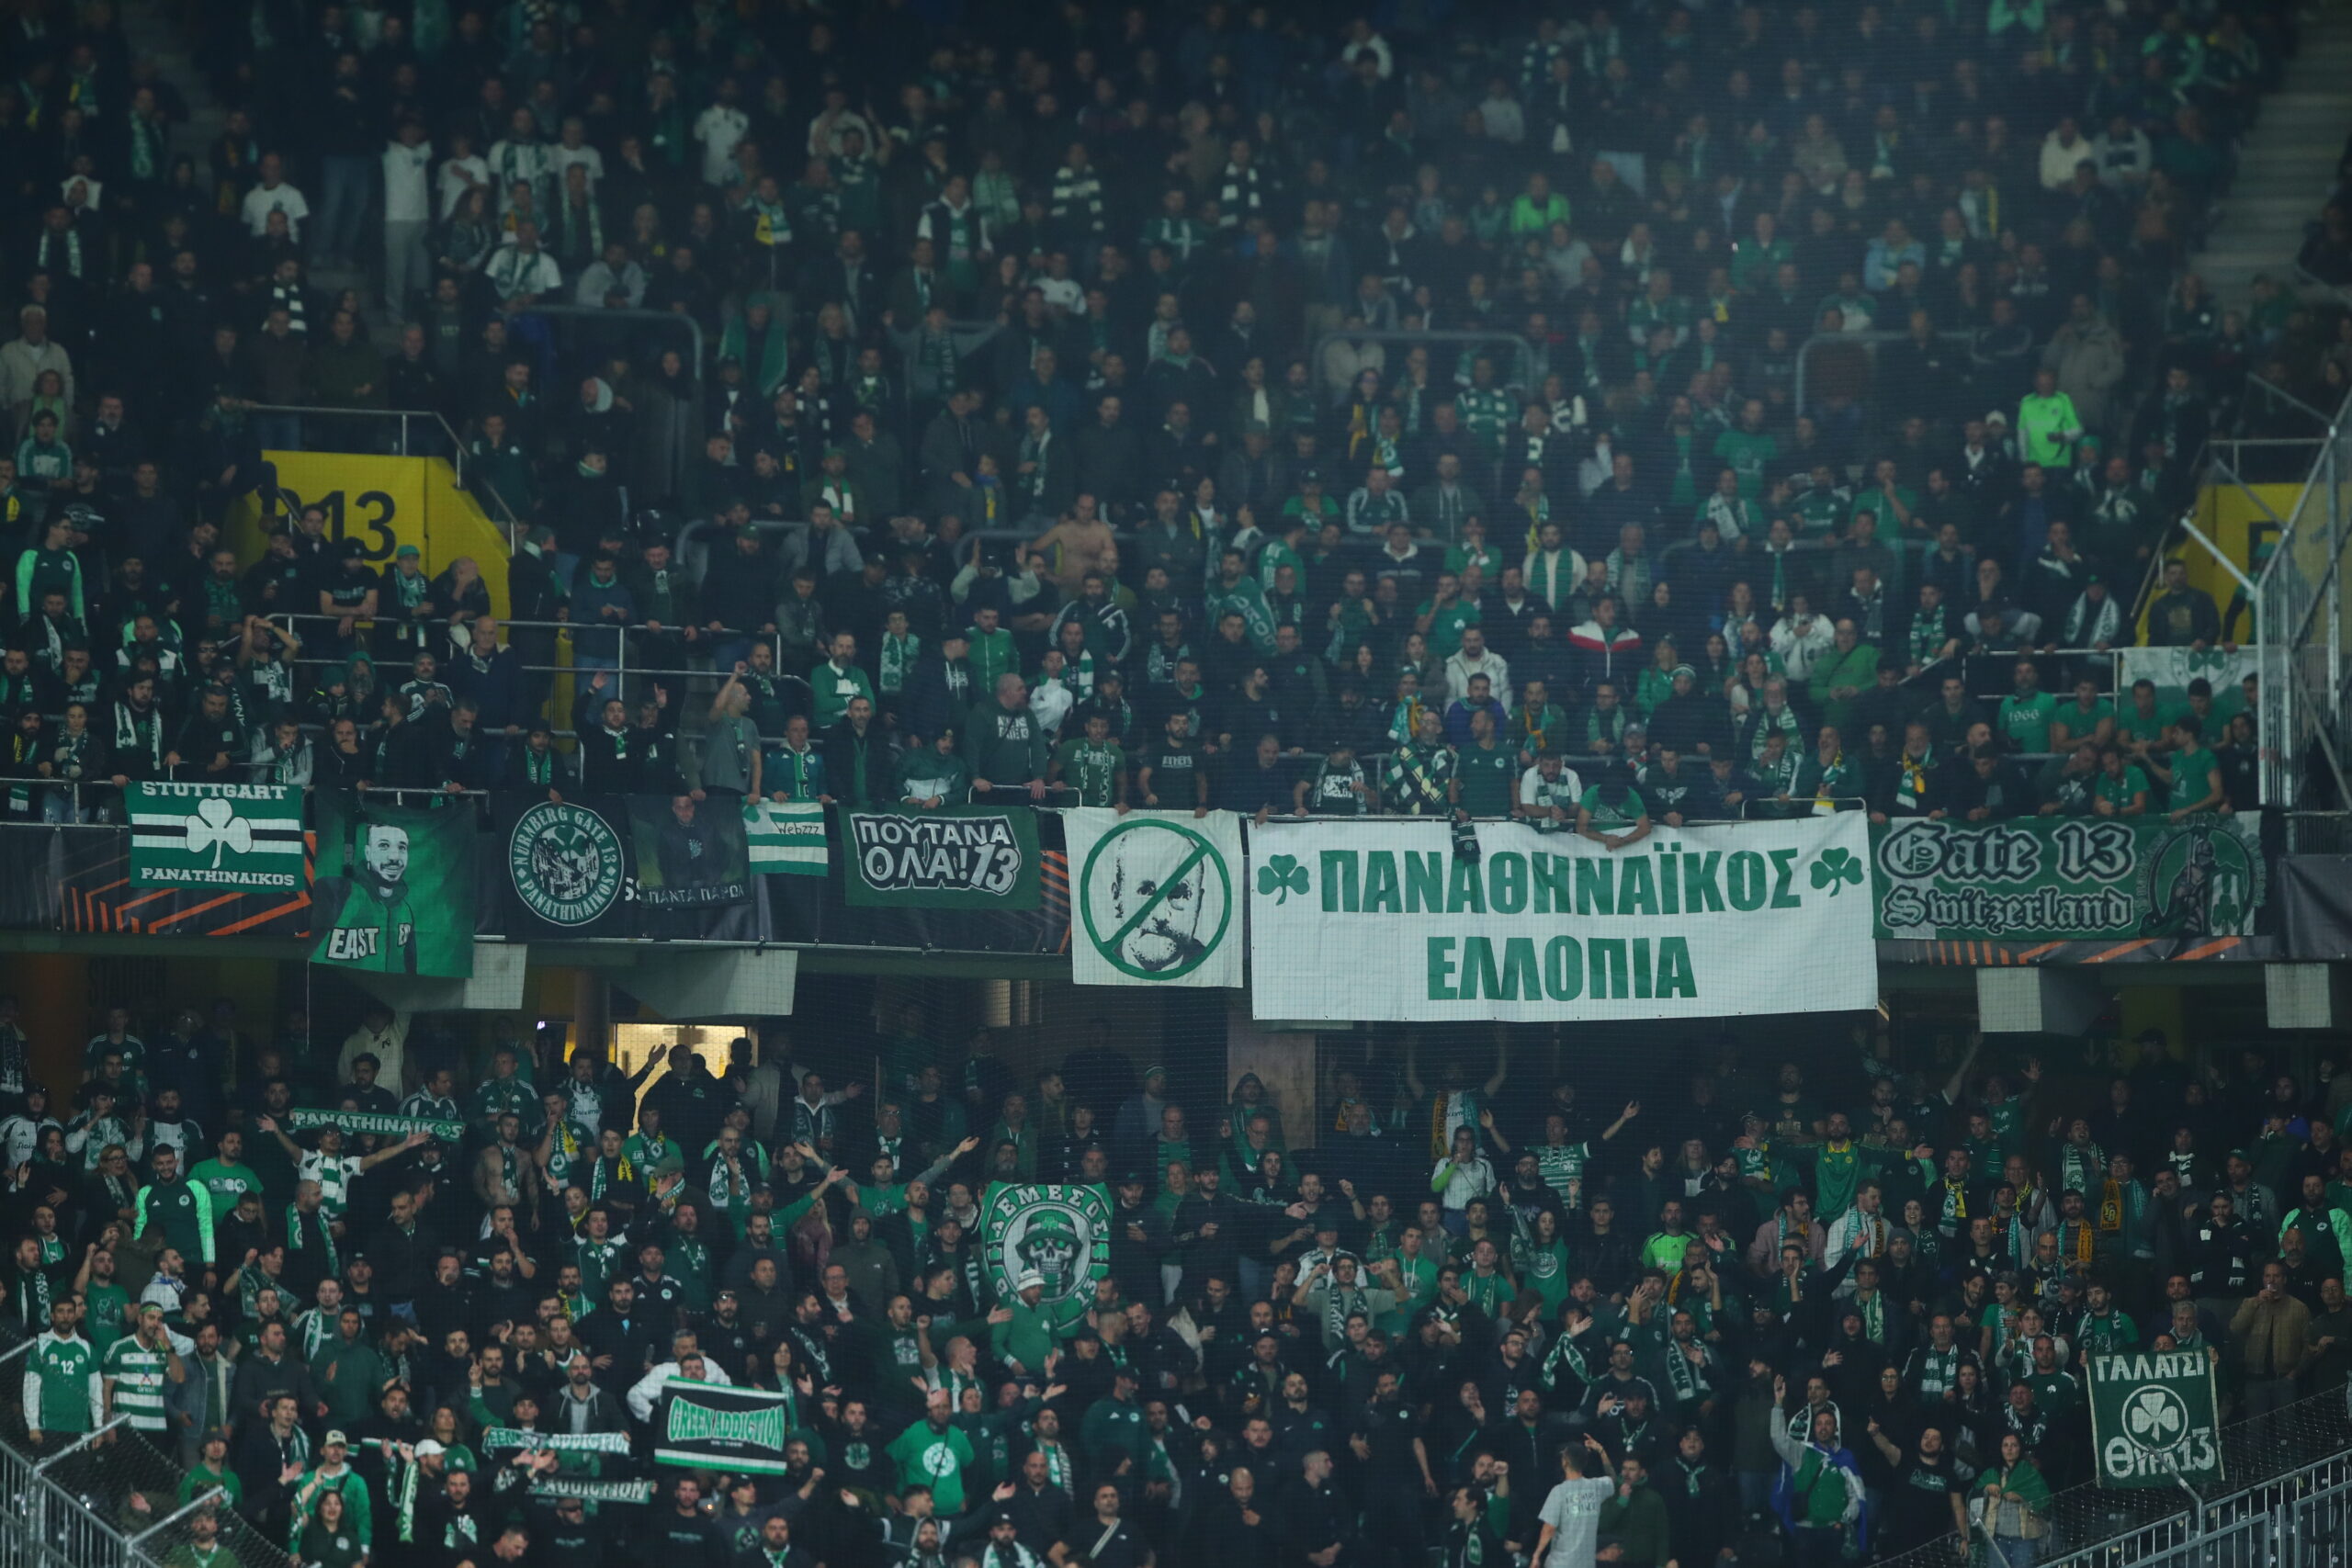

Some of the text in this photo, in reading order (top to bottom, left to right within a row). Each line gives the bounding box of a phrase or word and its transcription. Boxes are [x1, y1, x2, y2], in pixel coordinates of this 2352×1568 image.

[141, 781, 288, 800] STUTTGART
[514, 806, 617, 865] NÜRNBERG GATE 13
[859, 820, 1011, 845] ΠΟΥΤΑΝΑ
[1881, 822, 2040, 882] Gate
[2055, 824, 2133, 882] 13
[141, 867, 295, 886] PANATHINAIKOS
[865, 842, 1019, 893] ΟΛΑ! 13
[1320, 841, 1802, 916] ΠΑΝΑΘΗΝΑΪΚΟΣ
[519, 875, 616, 920] PANATHINAIKOS
[1883, 886, 2132, 934] Switzerland
[327, 928, 379, 960] EAST
[1428, 935, 1698, 1001] ΕΛΛΟΠΙΑ
[60, 1359, 74, 1375] 12
[2095, 1352, 2205, 1382] ΓΑΛΑΤΣΙ
[668, 1394, 786, 1452] GREEN ADDICTION
